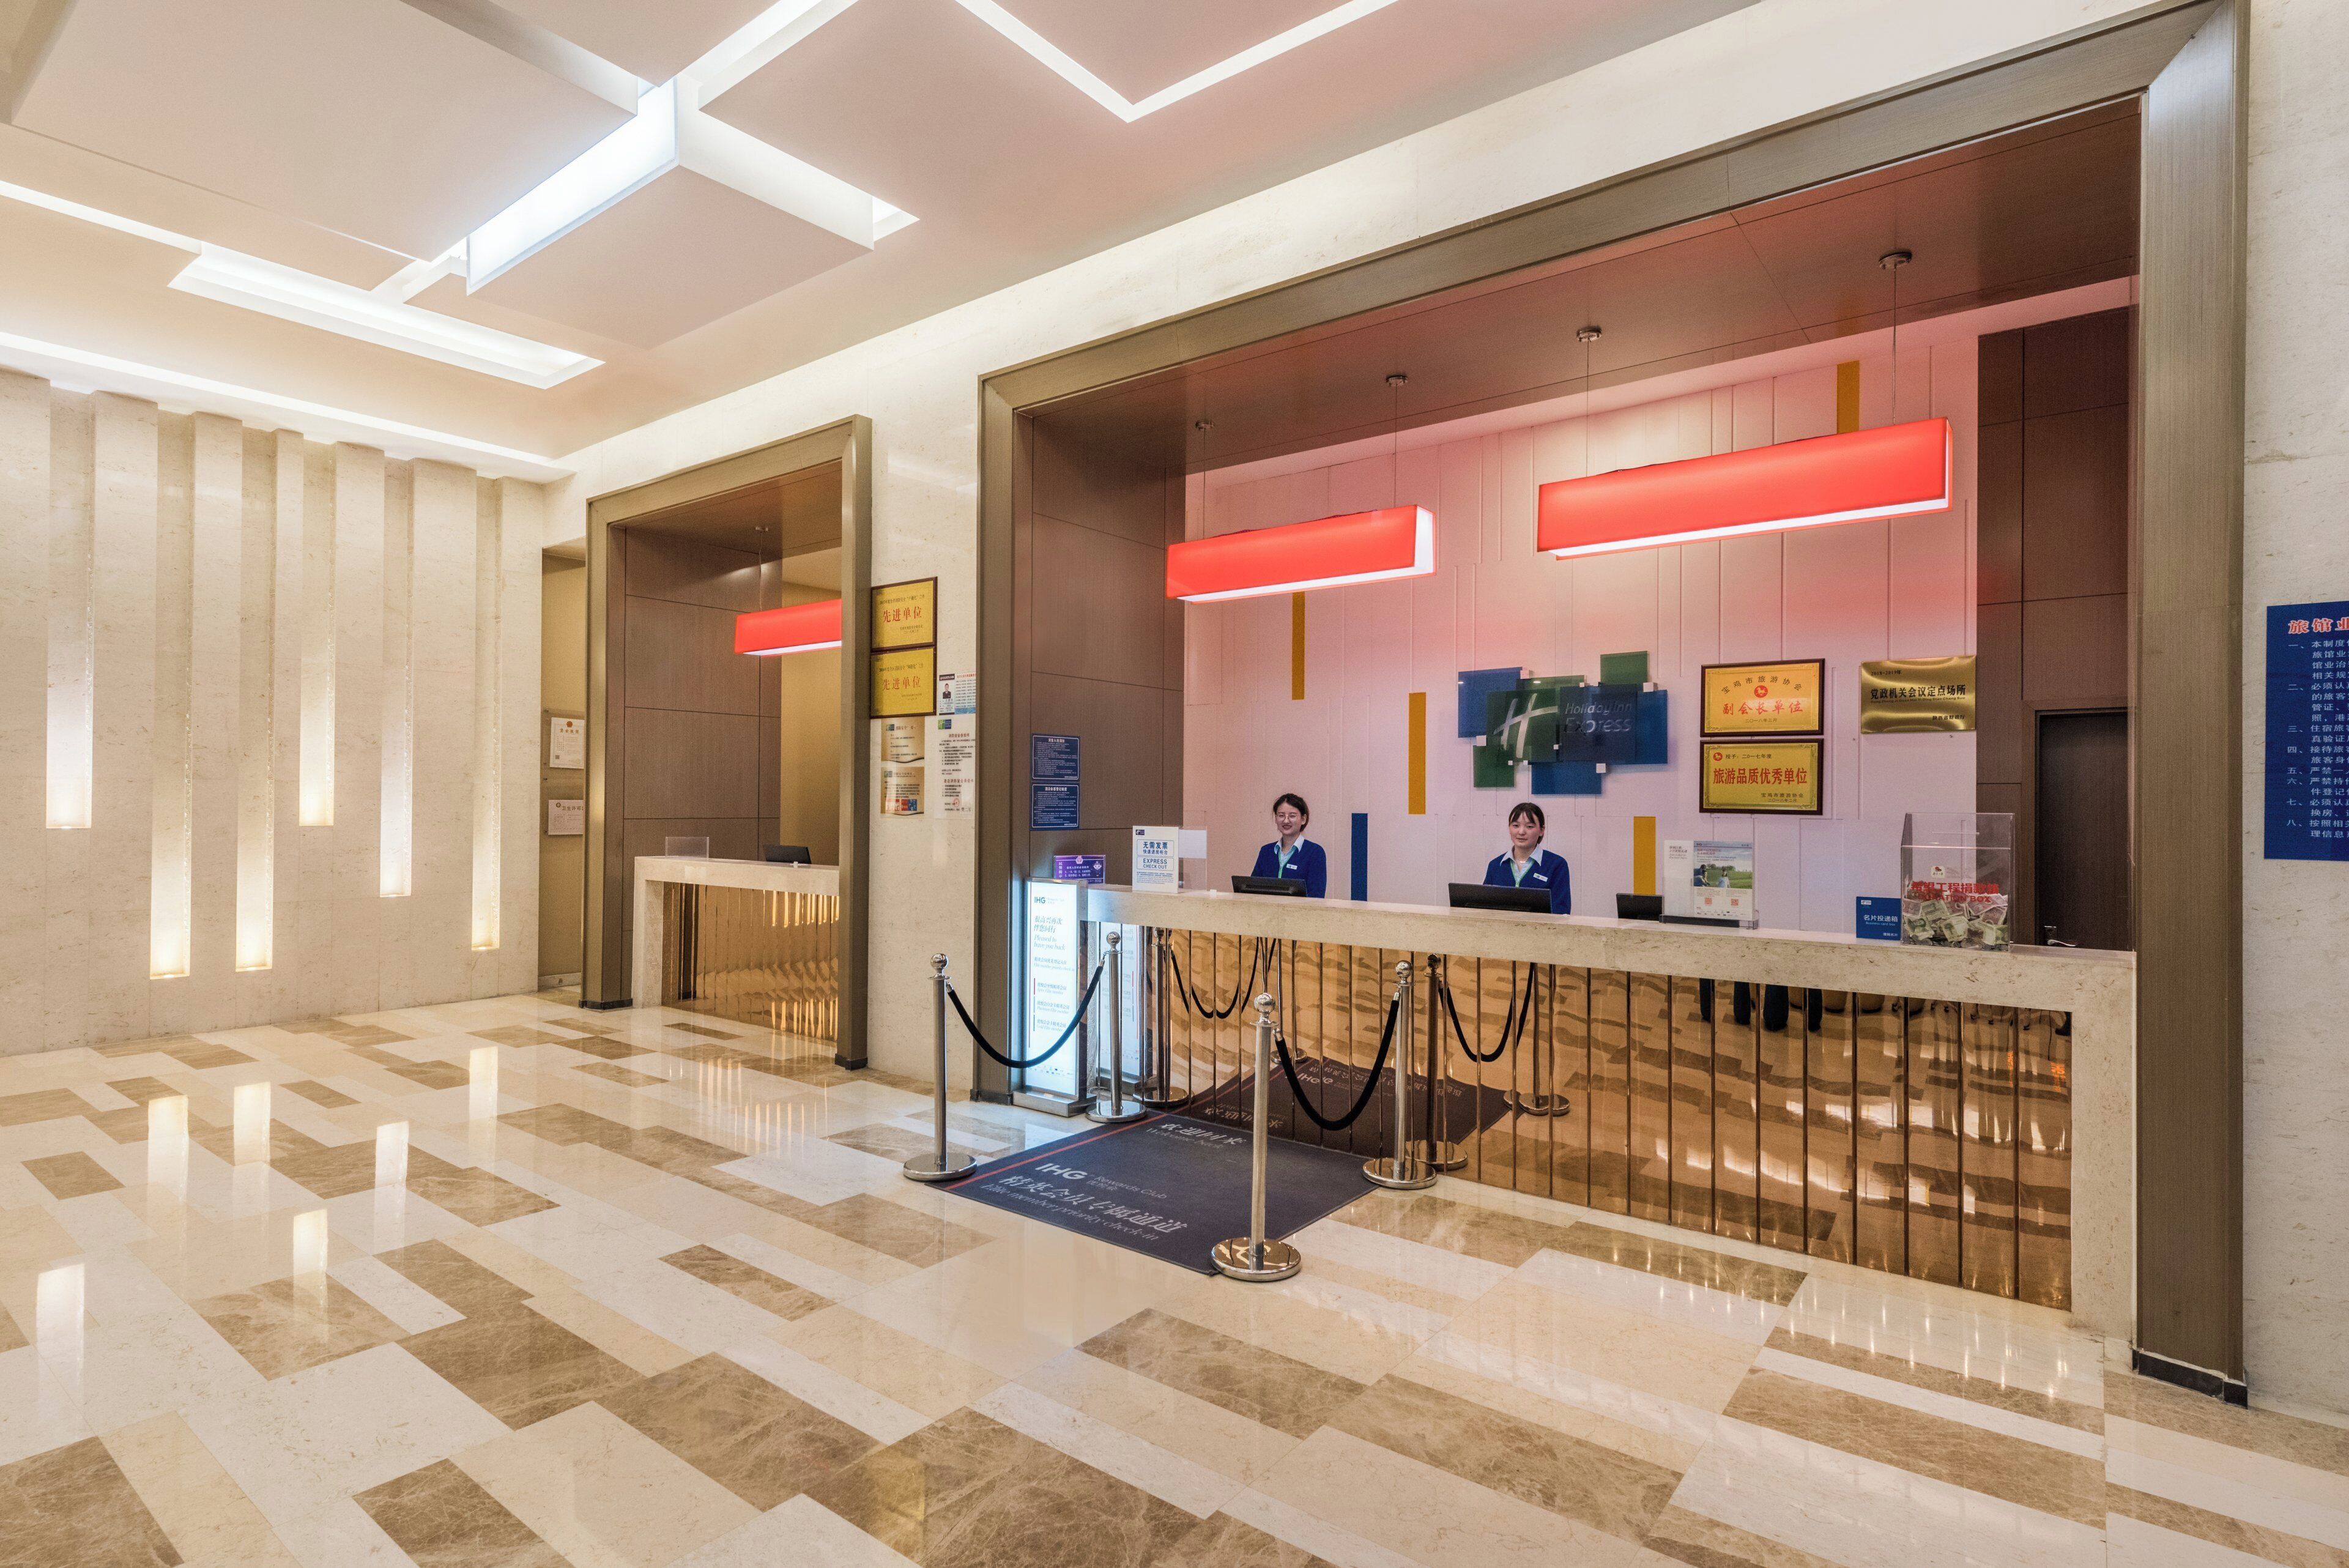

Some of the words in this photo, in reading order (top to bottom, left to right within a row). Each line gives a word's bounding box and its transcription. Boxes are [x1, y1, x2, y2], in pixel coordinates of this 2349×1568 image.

[883, 606, 921, 623] 先进单位
[2288, 640, 2349, 648] 一、本制度
[2312, 661, 2349, 669] 馆业治
[883, 675, 920, 691] 先进单位
[1721, 675, 1803, 695] 宝鸡市旅游协会
[1871, 684, 1966, 700] 党政机关会议定点场所
[1565, 702, 1610, 715] Holiday
[1723, 699, 1803, 715] 副会长单位
[1713, 767, 1807, 785] 旅游品质优秀单位
[1143, 841, 1168, 850] 无需发票
[1911, 881, 1999, 894] 希望工程捐款箱
[1863, 914, 1898, 923] 名片投递箱
[1157, 1124, 1247, 1145] 欢迎回来
[1034, 1163, 1088, 1180] IHG
[1093, 1176, 1140, 1192] Rewards
[1140, 1189, 1167, 1199] Club
[981, 1184, 1011, 1194] Elite
[1007, 1192, 1059, 1208] member
[1052, 1207, 1101, 1223] priority
[1102, 1219, 1159, 1241] check-in
